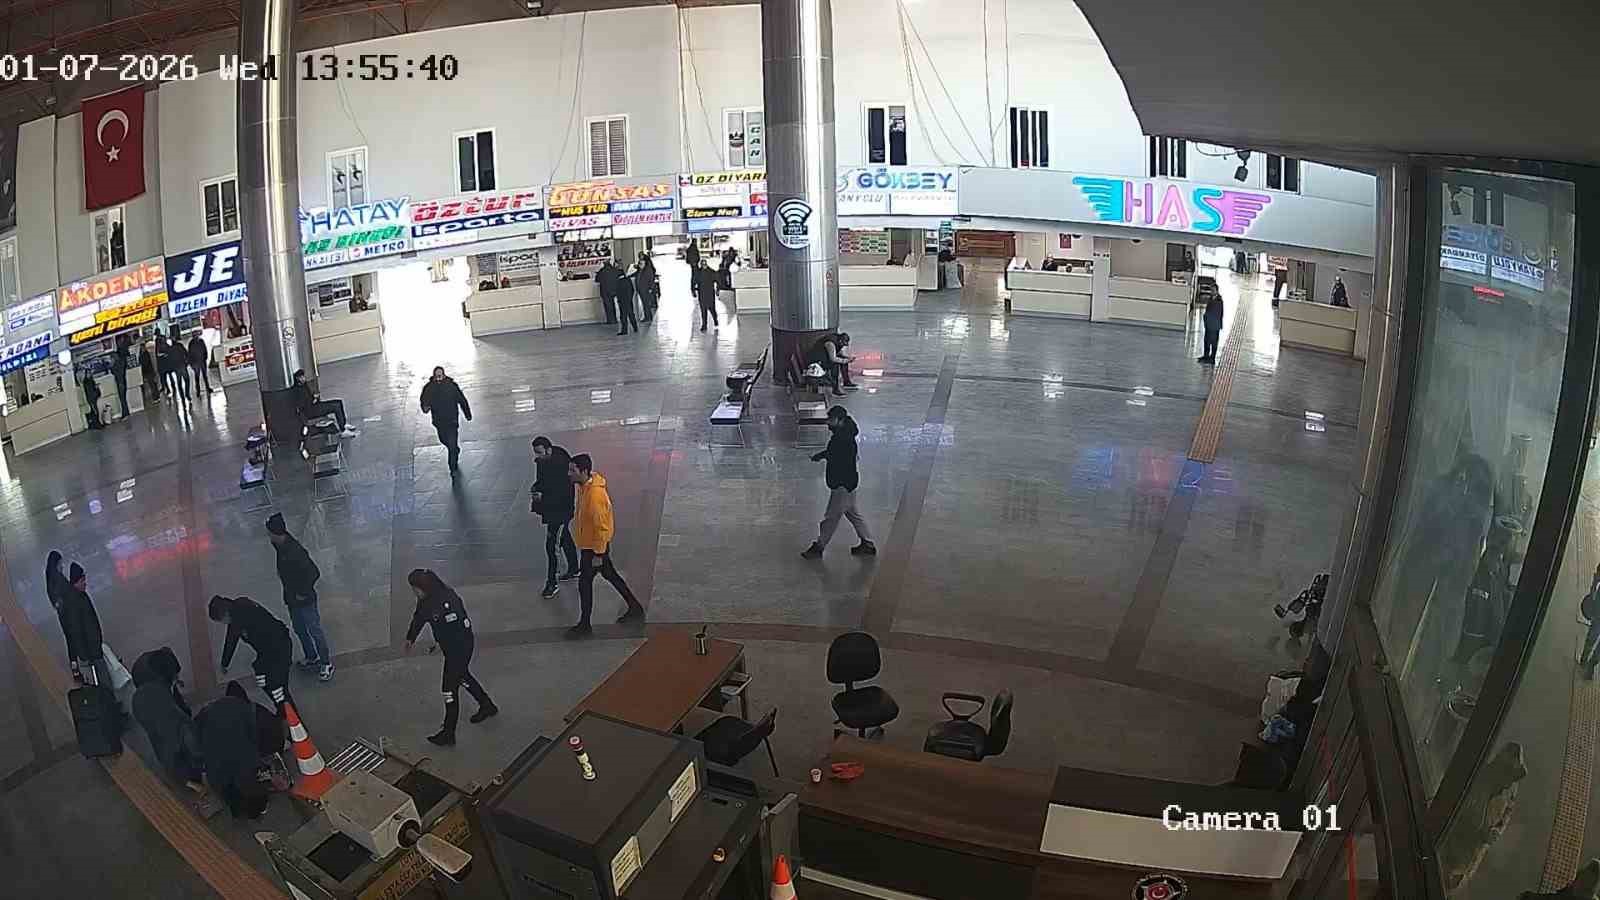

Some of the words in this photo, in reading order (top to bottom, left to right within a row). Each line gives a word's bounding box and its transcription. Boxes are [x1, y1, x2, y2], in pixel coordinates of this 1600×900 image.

[857, 167, 953, 189] GÖKBEY
[311, 197, 407, 234] HATAY
[1125, 181, 1224, 233] HAS
[364, 240, 405, 257] METRO
